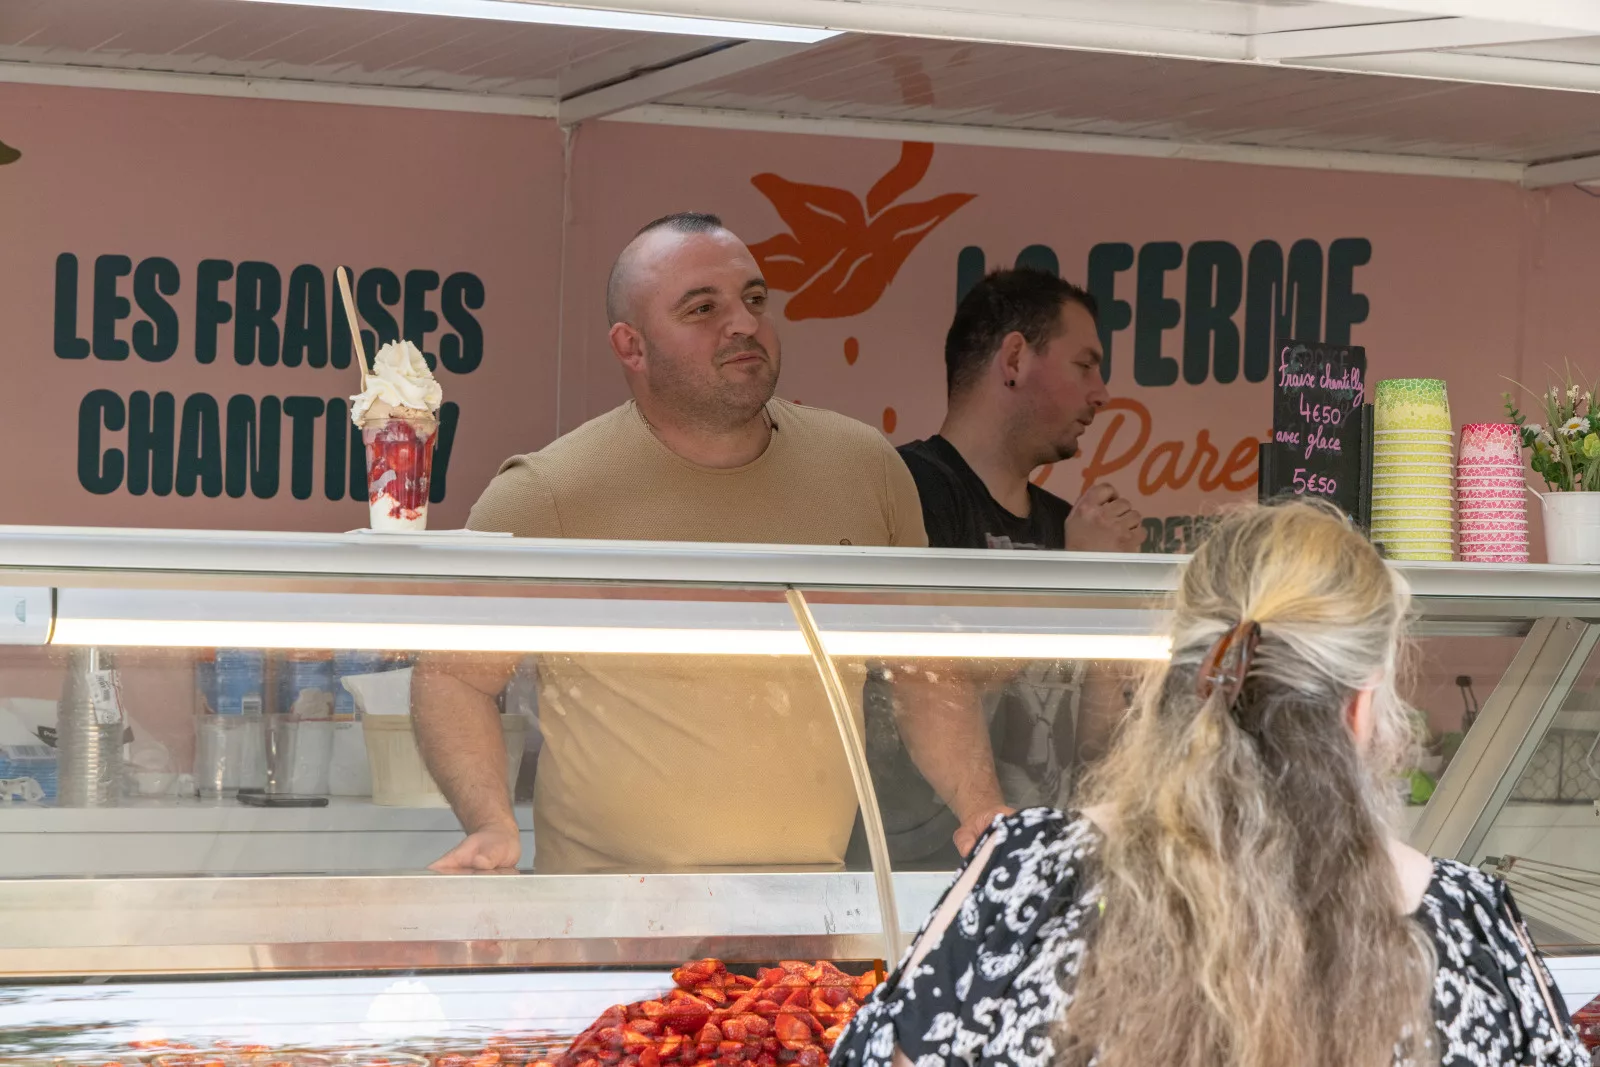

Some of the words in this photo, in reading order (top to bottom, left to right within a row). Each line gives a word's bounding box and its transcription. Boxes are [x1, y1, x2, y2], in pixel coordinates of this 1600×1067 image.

[54, 252, 180, 362] LES
[195, 258, 486, 374] FRAISES
[1088, 237, 1372, 387] FERME
[1299, 392, 1341, 425] 4€50
[1276, 430, 1300, 444] avec
[1305, 425, 1342, 460] glace
[1292, 468, 1337, 494] 5€50
